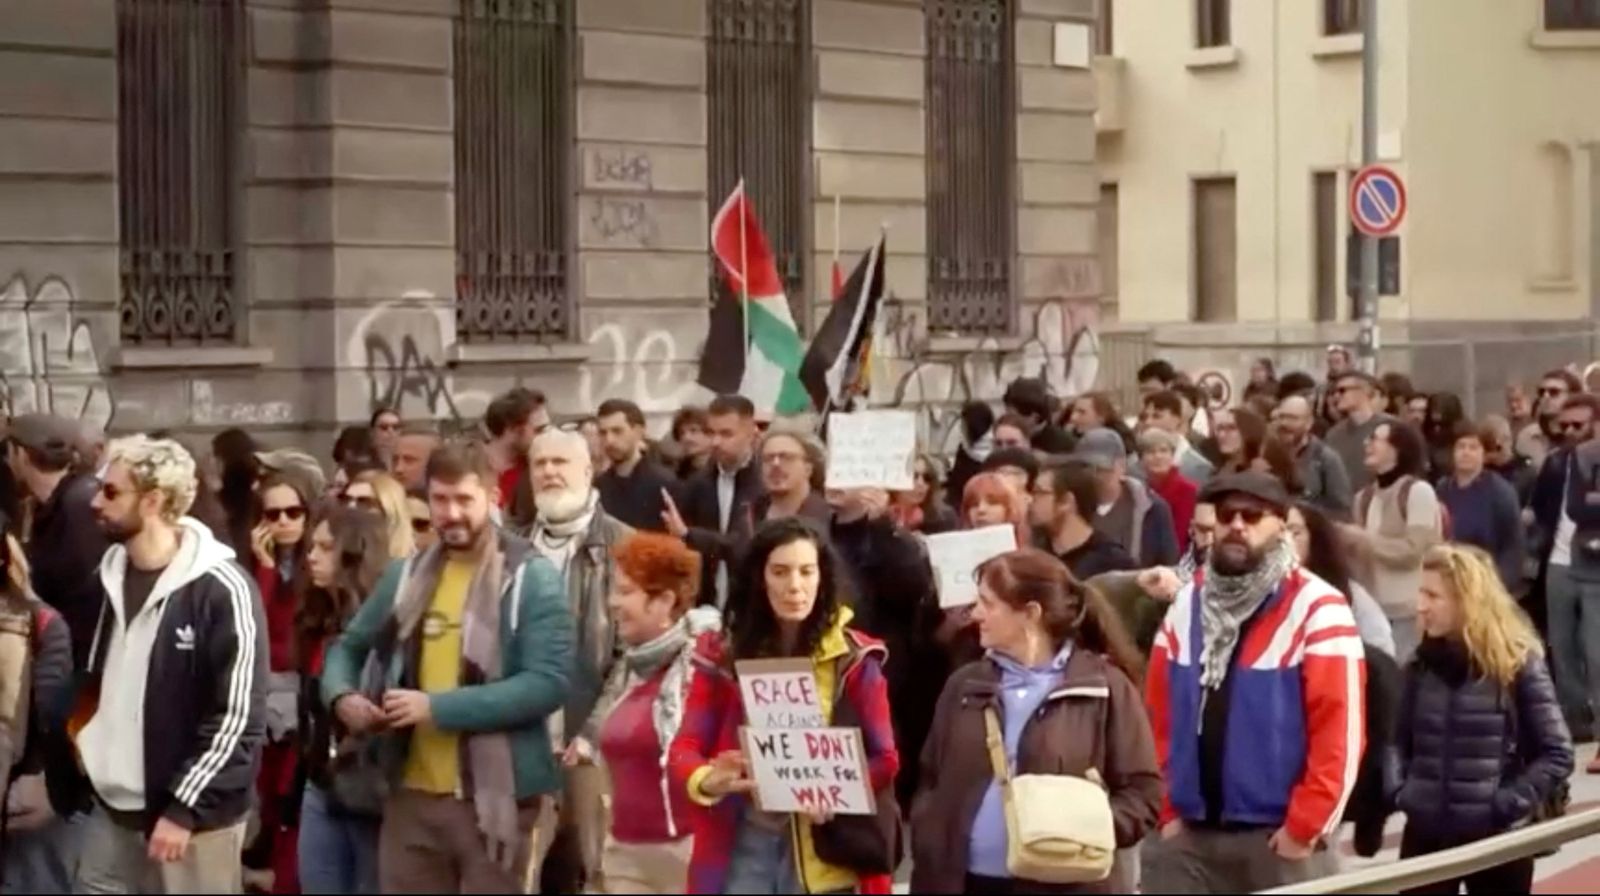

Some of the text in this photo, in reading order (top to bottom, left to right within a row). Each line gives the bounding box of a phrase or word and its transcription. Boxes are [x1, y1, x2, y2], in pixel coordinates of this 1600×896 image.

[754, 733, 794, 760] WE
[774, 765, 825, 780] WORK
[791, 785, 850, 813] WAR
